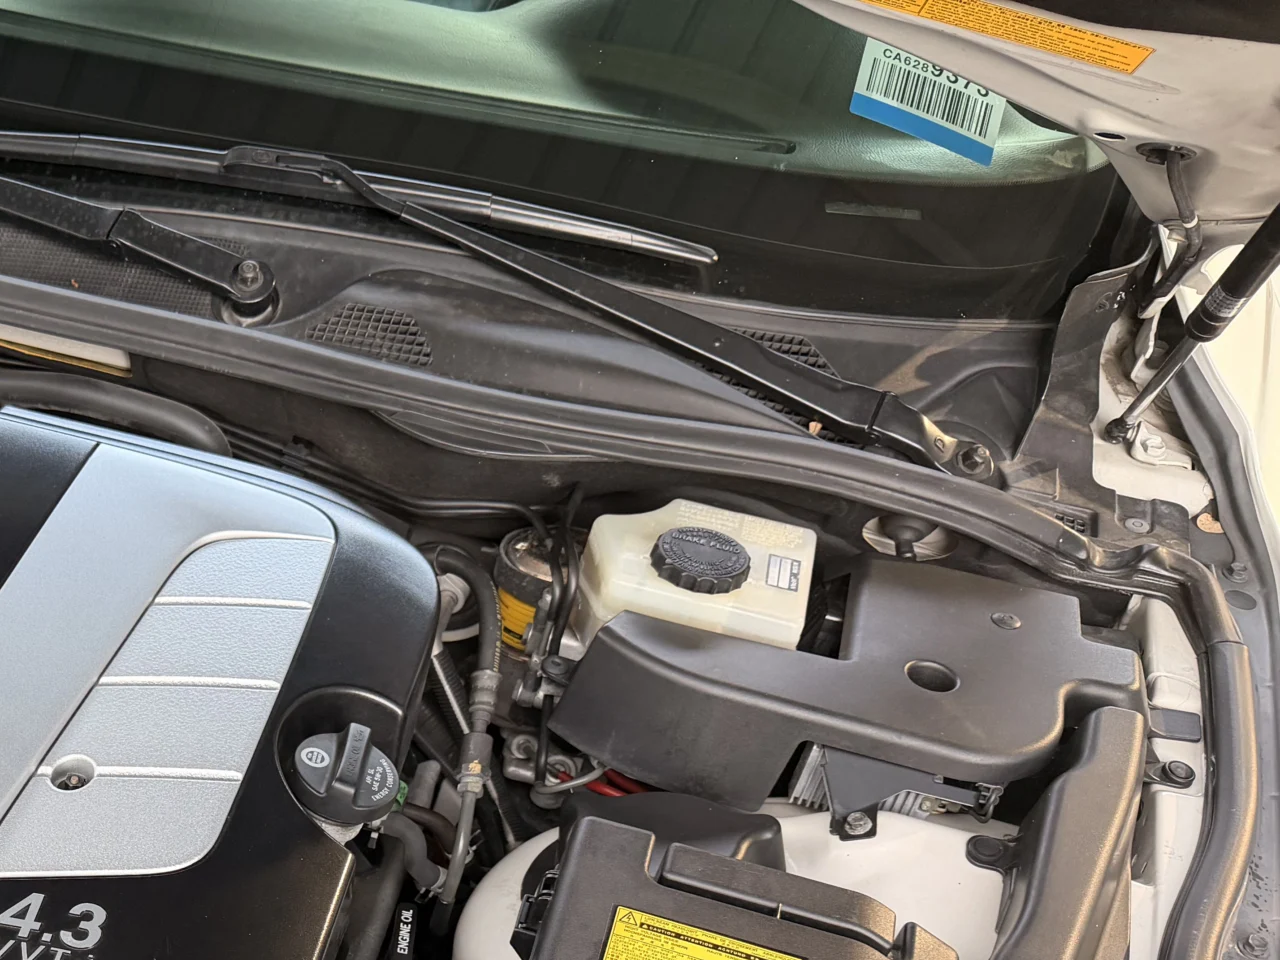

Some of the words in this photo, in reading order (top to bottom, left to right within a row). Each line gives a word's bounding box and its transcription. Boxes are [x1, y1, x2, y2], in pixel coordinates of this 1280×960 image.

[401, 910, 412, 920] OIL
[396, 922, 411, 954] ENGINE
[648, 925, 675, 937] CAUTION
[679, 934, 713, 948] ATTENTION
[717, 946, 746, 957] ACHTUNG
